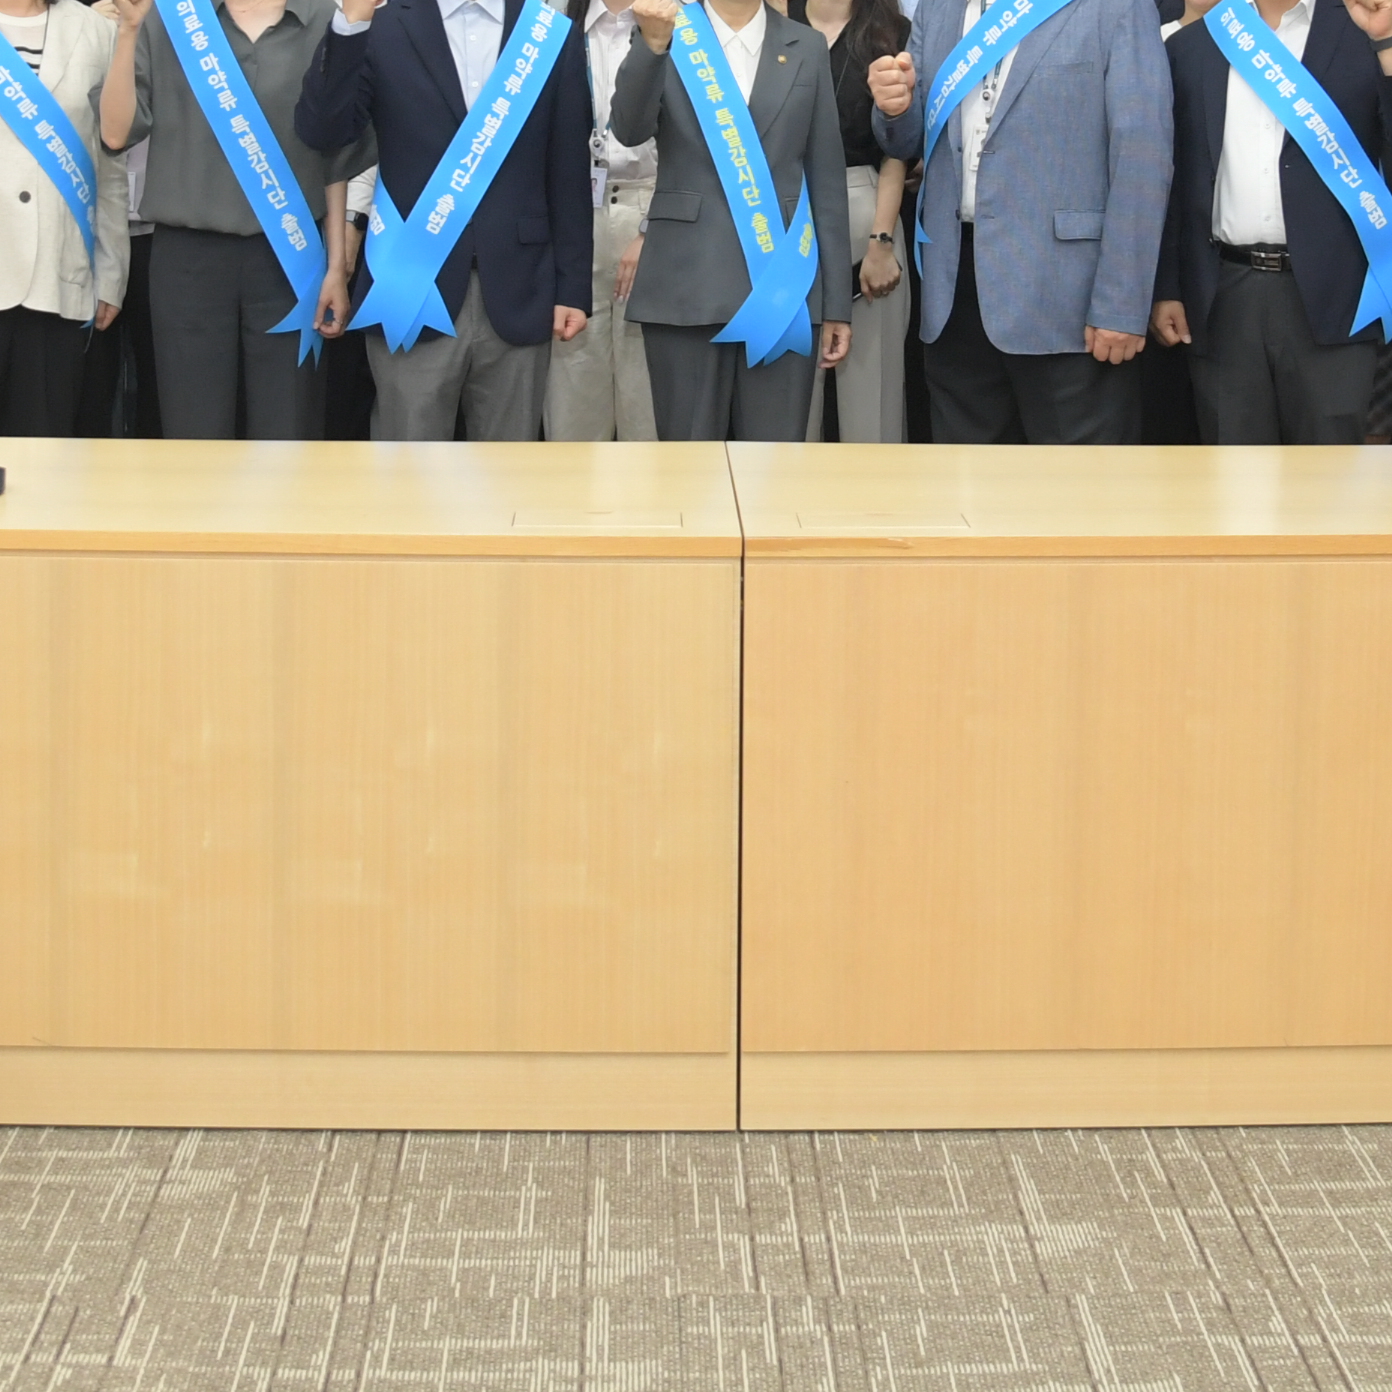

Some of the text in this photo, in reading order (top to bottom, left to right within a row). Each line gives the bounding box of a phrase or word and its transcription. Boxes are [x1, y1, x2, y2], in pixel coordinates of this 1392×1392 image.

[982, 0, 1034, 48] 마약류
[504, 44, 540, 96] 마약류
[34, 119, 91, 203] 특별감시단
[200, 52, 238, 112] 마약류
[230, 114, 288, 210] 특별감시단
[279, 213, 307, 251] 출범
[450, 97, 511, 192] 특별감시단
[689, 49, 725, 103] 마약류
[715, 108, 762, 208] 특별감시단
[751, 213, 776, 254] 출범
[1220, 7, 1388, 231] 의료용 마약류 특별감시단 출범
[425, 194, 456, 235] 출범
